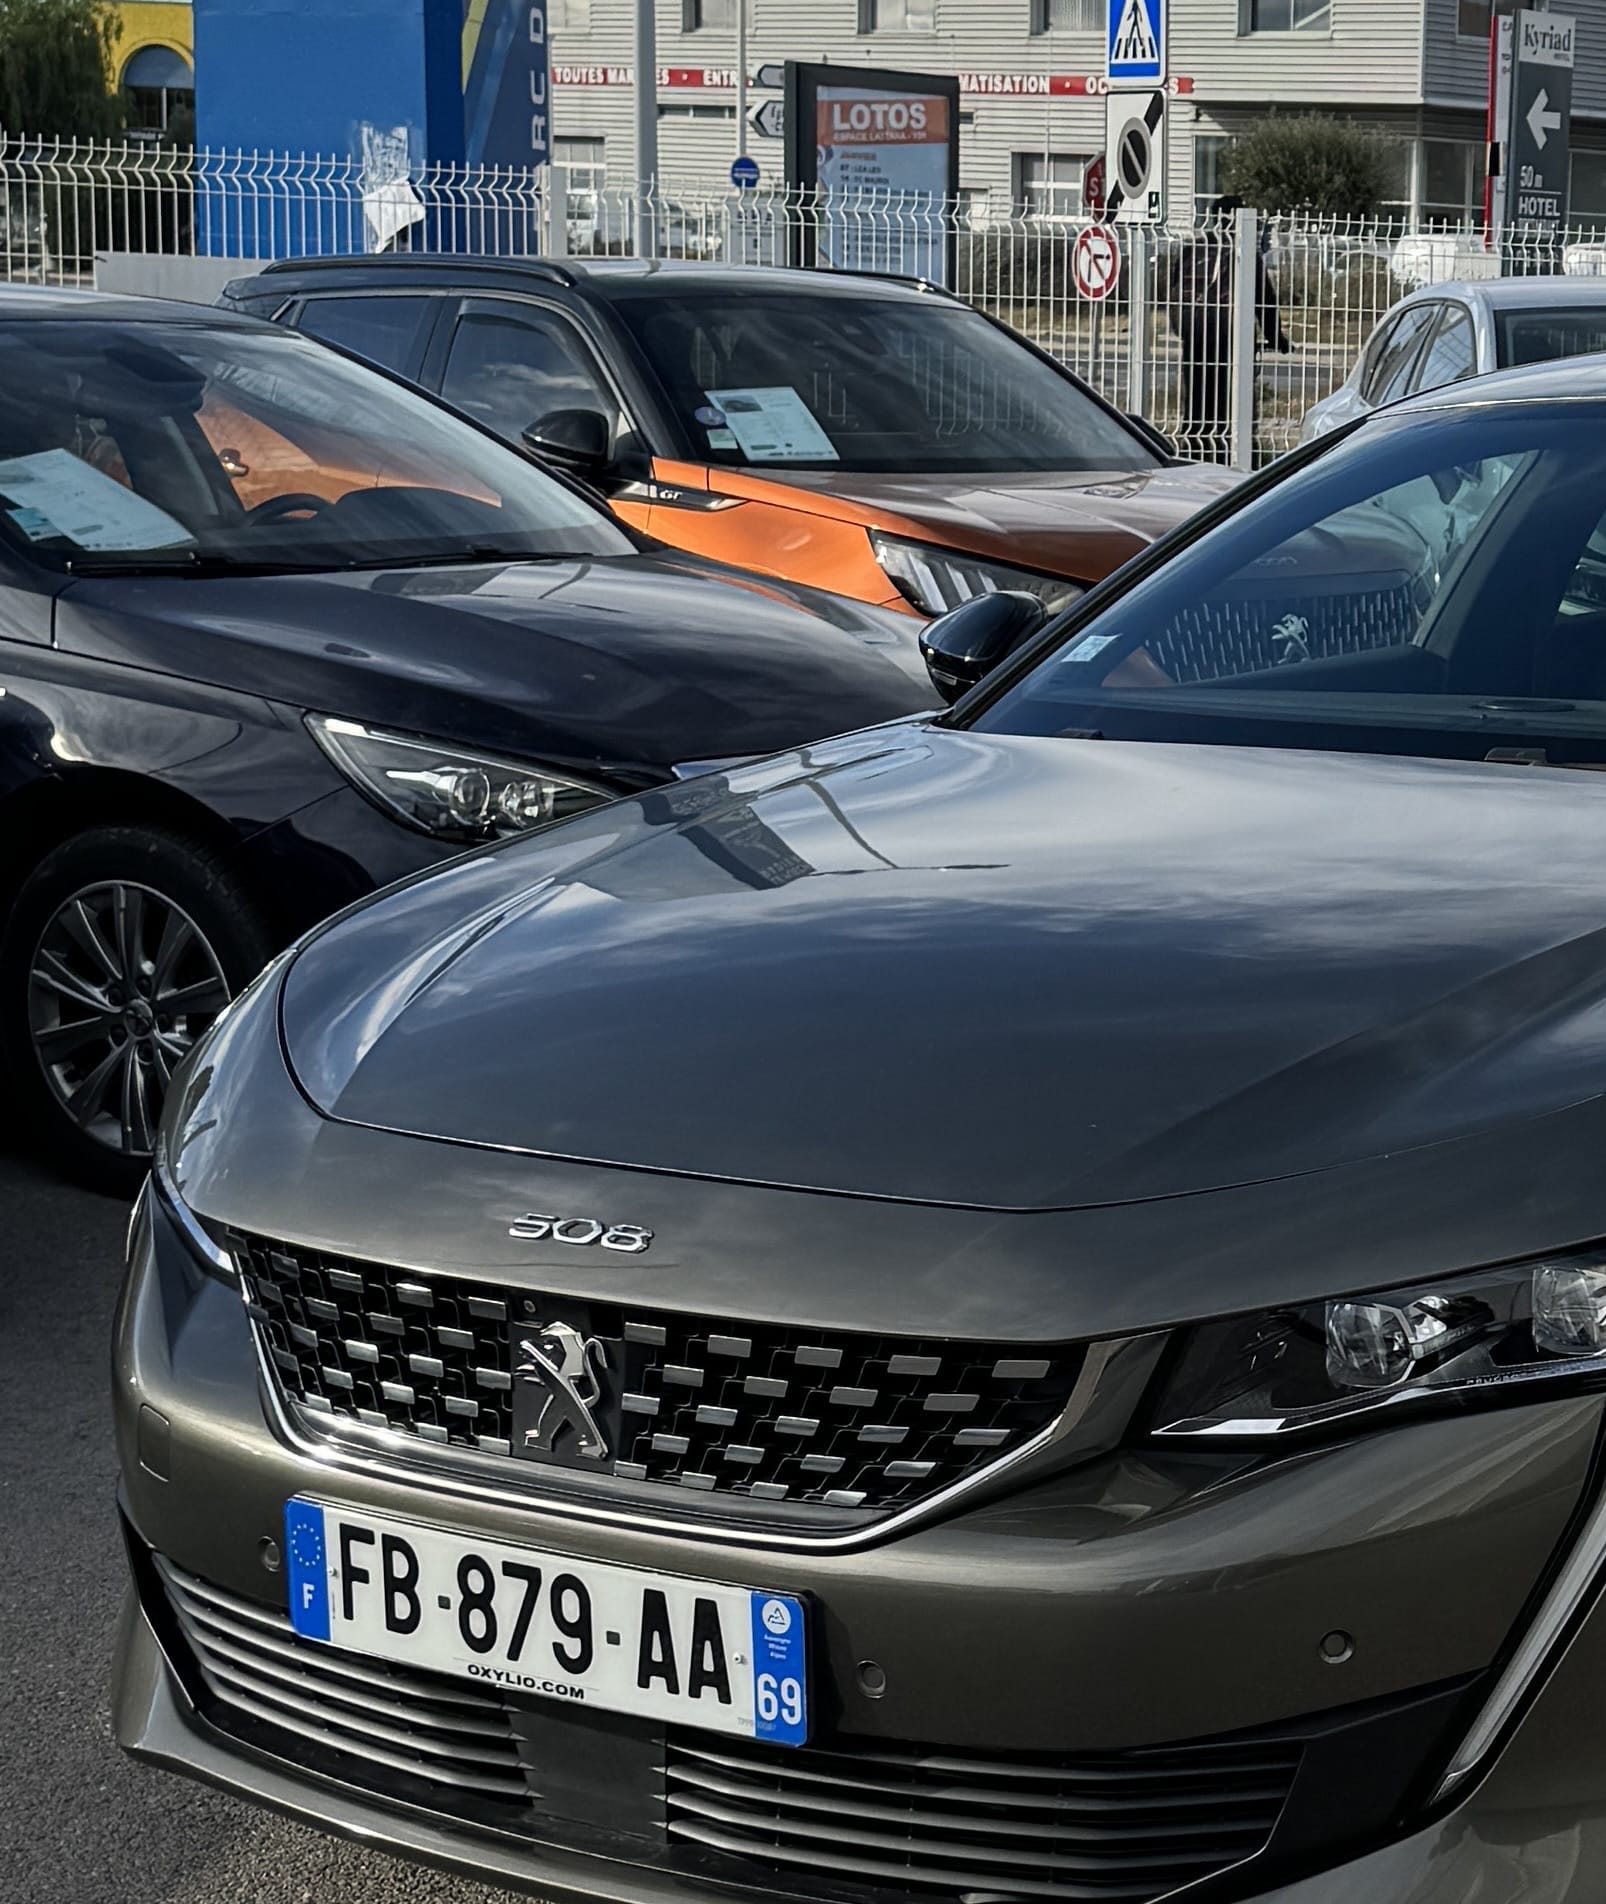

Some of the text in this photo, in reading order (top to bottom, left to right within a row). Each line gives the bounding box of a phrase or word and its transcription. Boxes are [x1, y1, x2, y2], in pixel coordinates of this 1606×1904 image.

[1524, 22, 1572, 56] Kyriad
[554, 66, 604, 84] TOUTES
[606, 68, 670, 85] MARES
[959, 73, 1050, 93] MATISATION
[833, 103, 927, 131] LOTOS
[1519, 165, 1534, 188] 50
[1518, 196, 1561, 217] HOTEL
[659, 489, 683, 500] GT
[508, 1212, 655, 1254] 508
[302, 1581, 315, 1609] F
[338, 1521, 733, 1705] FB-879-AA
[466, 1662, 585, 1700] OXYLIO.COM
[756, 1672, 802, 1726] 69
